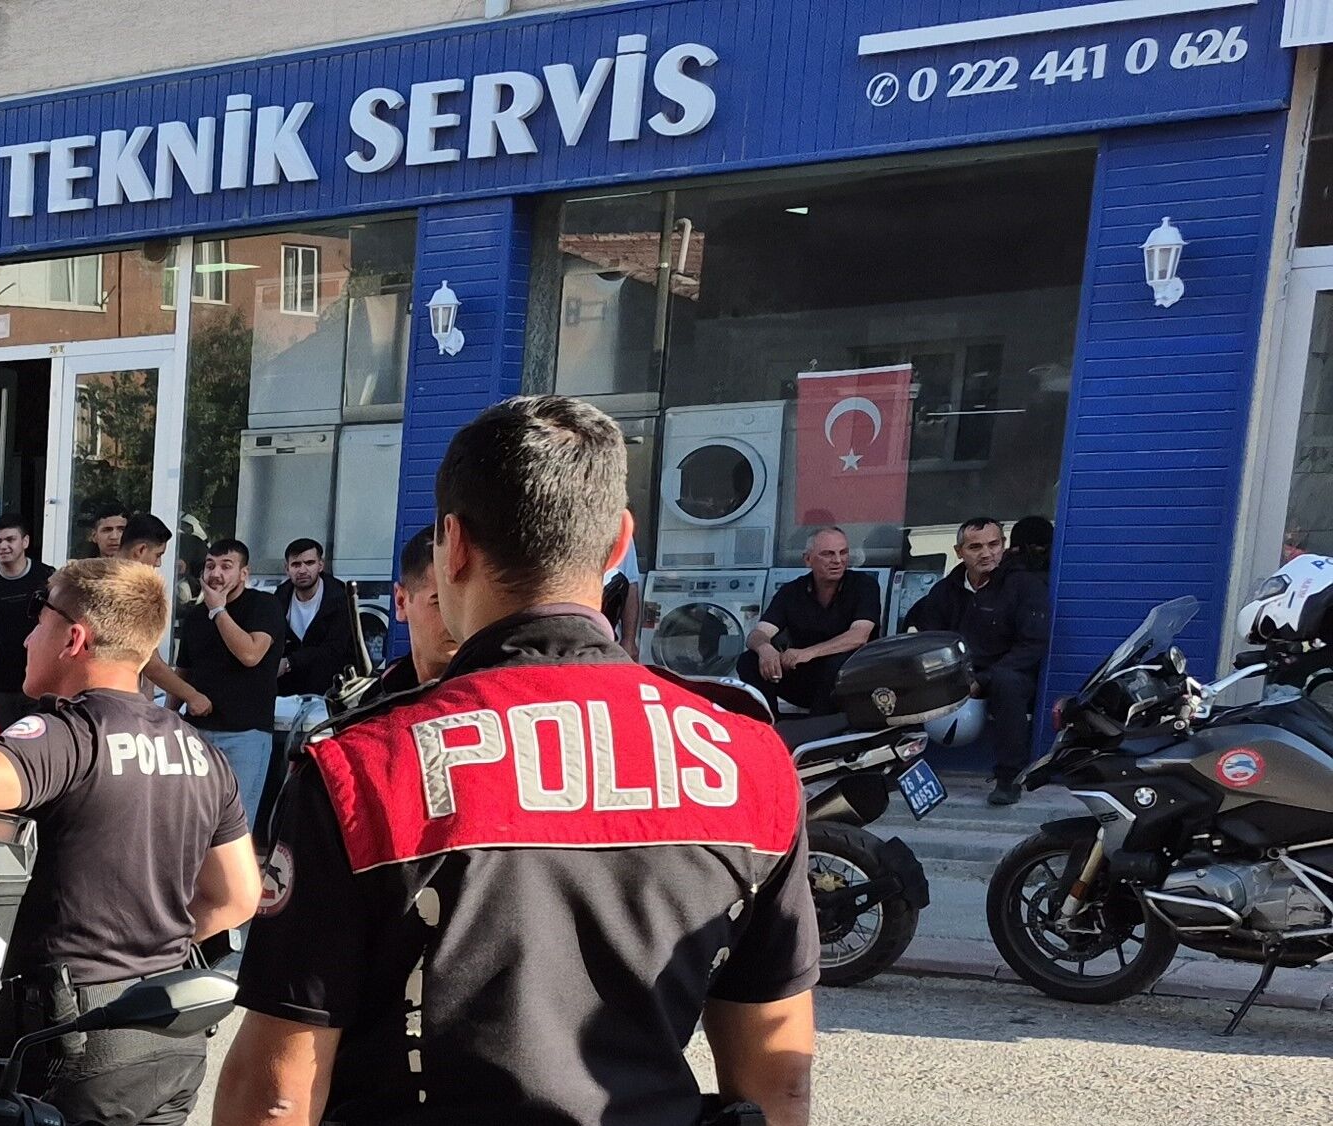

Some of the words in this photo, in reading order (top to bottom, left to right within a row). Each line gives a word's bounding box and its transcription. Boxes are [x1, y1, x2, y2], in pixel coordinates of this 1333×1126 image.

[345, 33, 720, 174] SERVİS
[907, 67, 938, 102] 0
[946, 56, 1021, 98] 222
[1030, 43, 1108, 86] 441
[1124, 37, 1159, 75] 0
[1170, 25, 1249, 70] 626
[410, 683, 739, 820] POLİS
[914, 768, 926, 784] A
